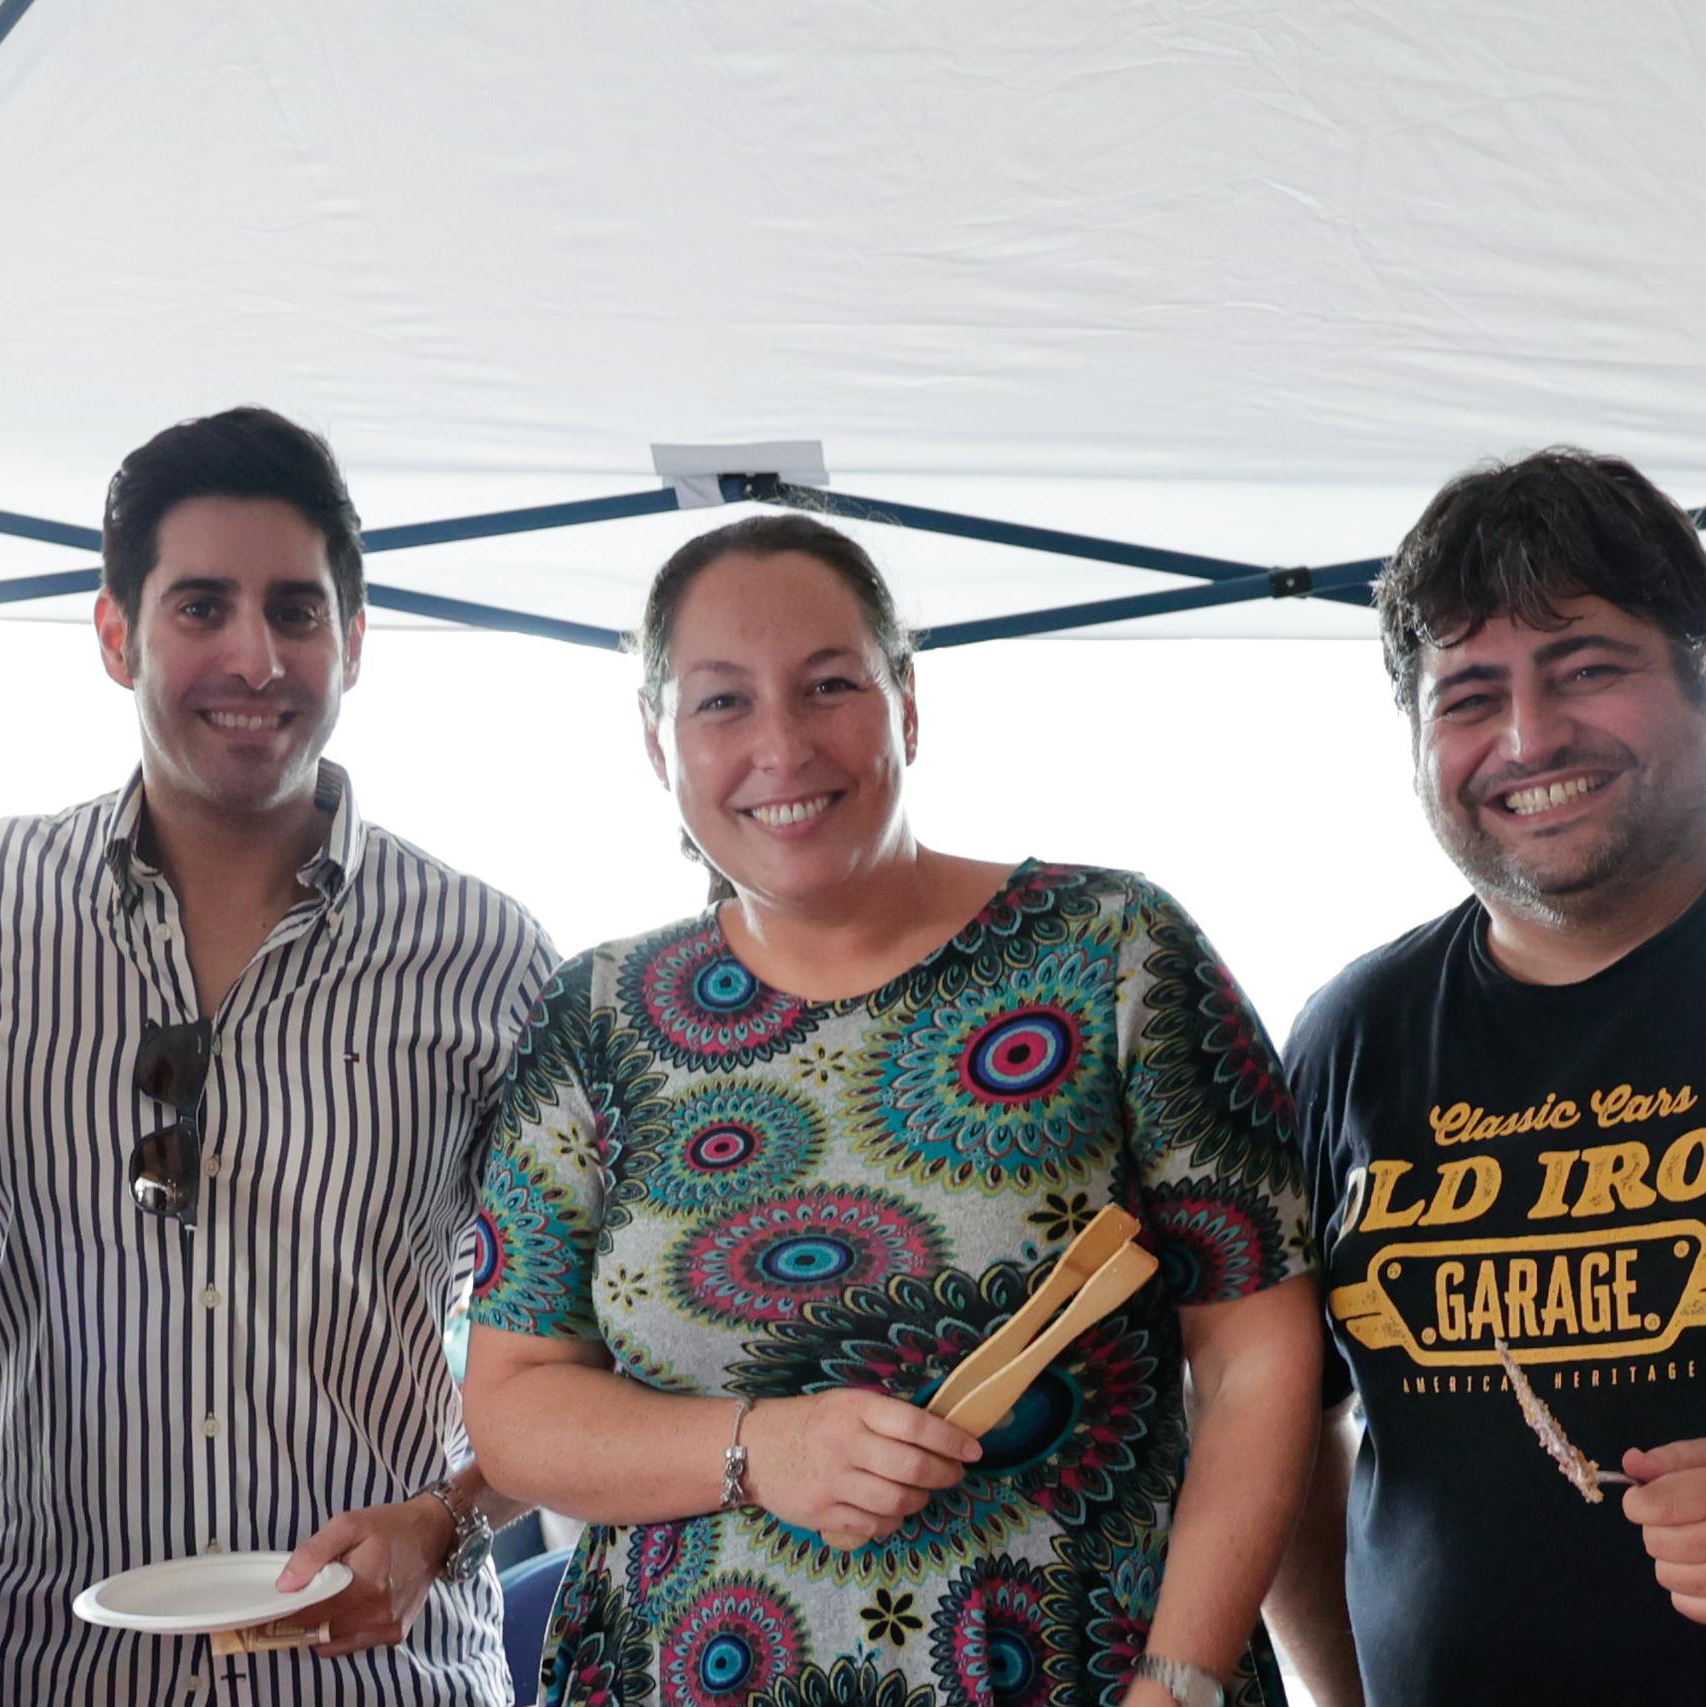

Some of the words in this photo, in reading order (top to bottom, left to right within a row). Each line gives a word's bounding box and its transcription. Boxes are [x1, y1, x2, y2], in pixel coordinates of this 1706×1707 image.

[1430, 1096, 1581, 1146] Classic
[1591, 1083, 1698, 1120] Cars
[1435, 1249, 1646, 1343] GARAGE
[1403, 1376, 1519, 1394] AMERICA
[1553, 1359, 1696, 1390] HERITAGE
